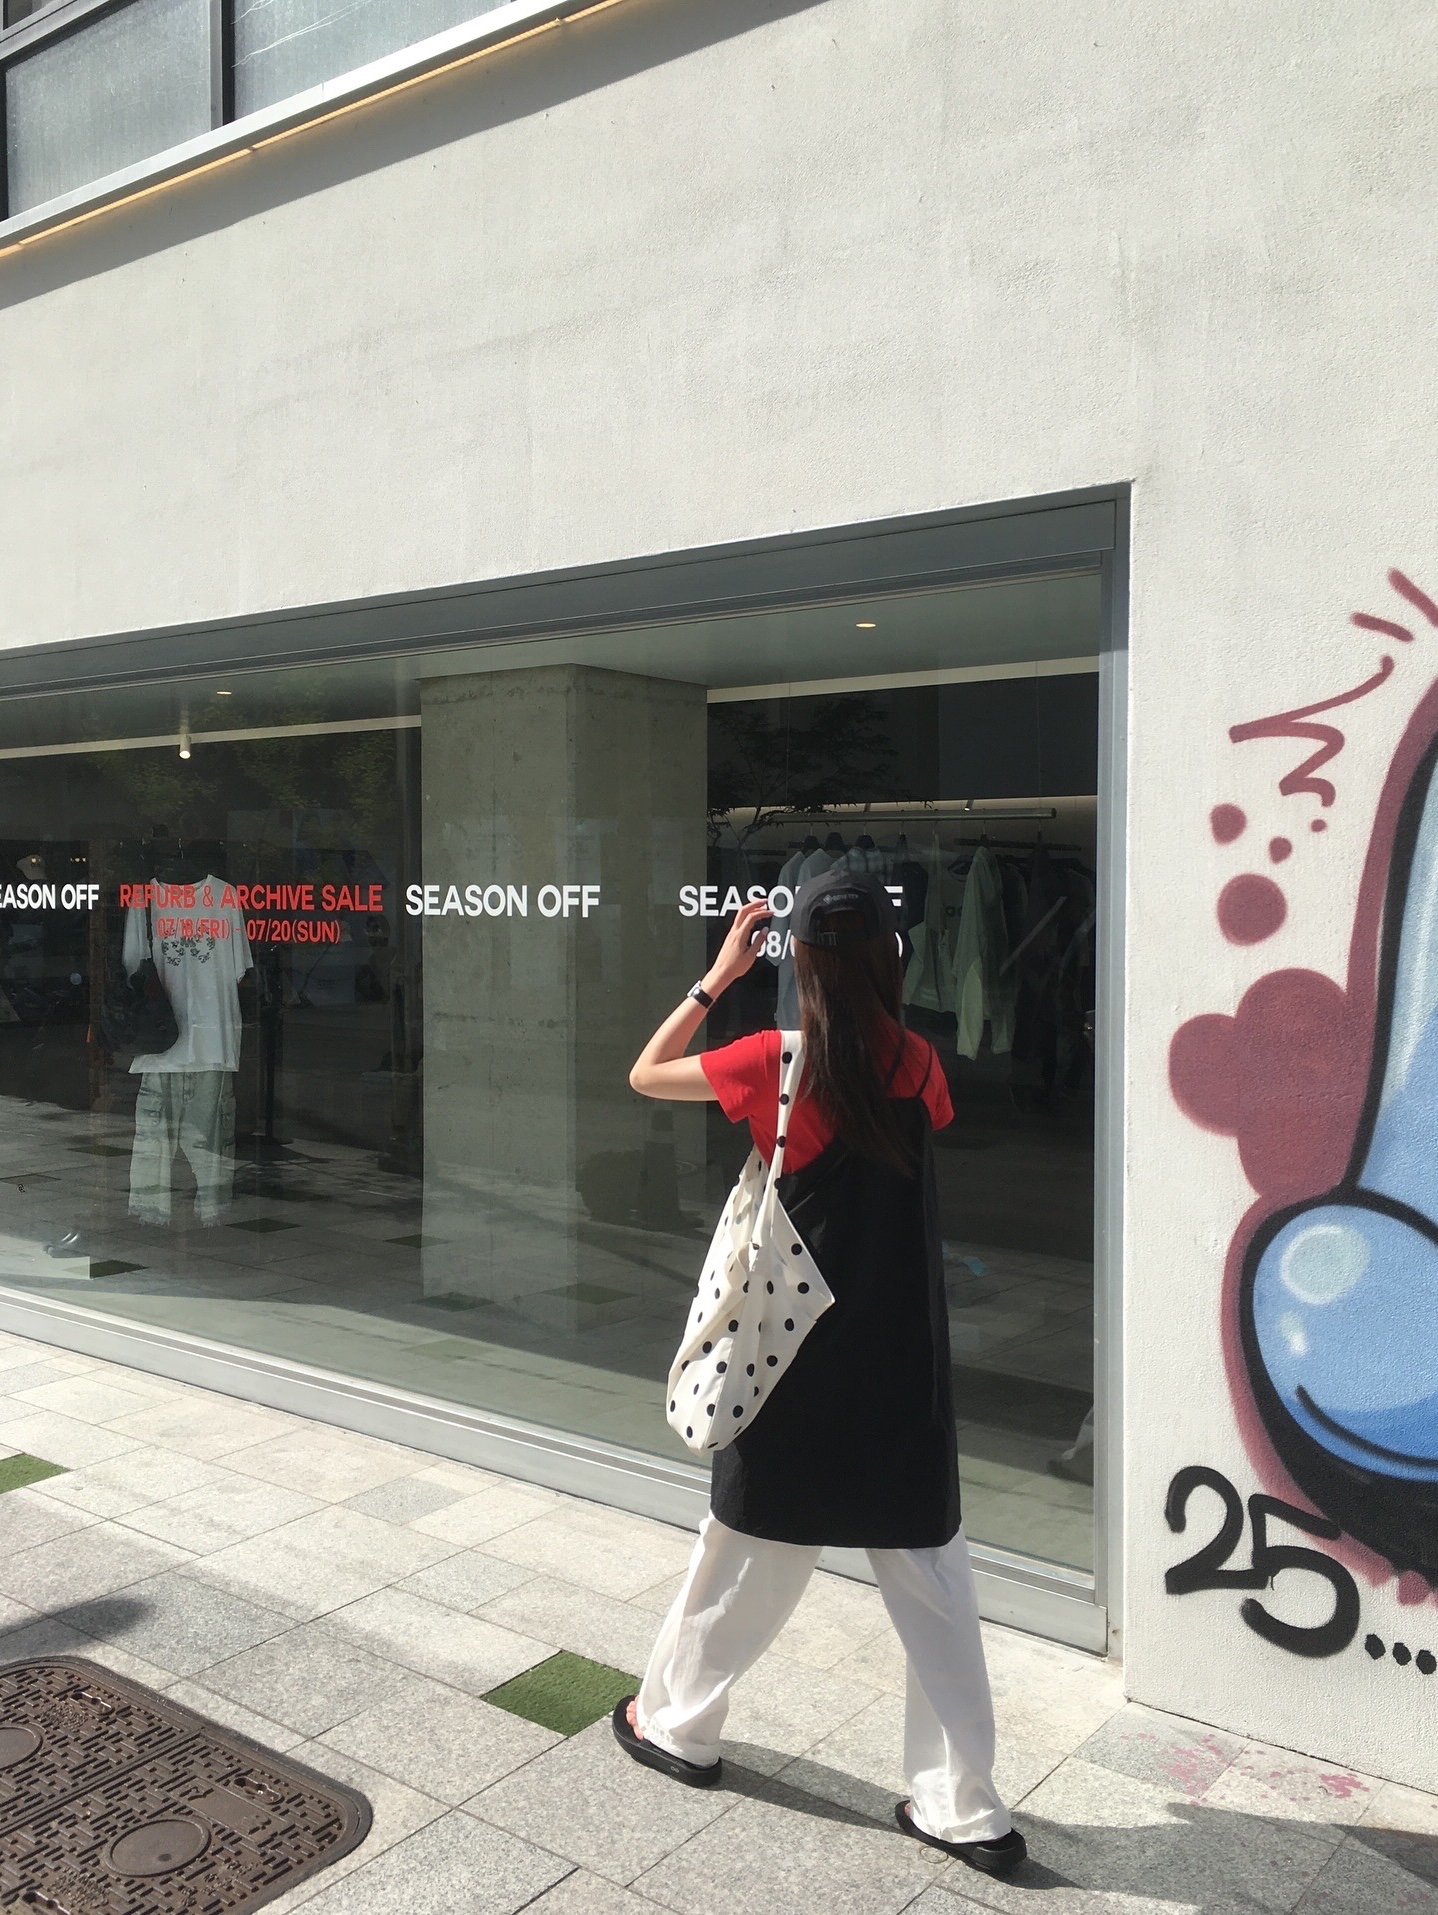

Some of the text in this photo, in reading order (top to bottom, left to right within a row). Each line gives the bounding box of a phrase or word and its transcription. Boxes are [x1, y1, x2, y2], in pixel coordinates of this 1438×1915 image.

[0, 884, 99, 910] ASON OFF
[119, 884, 384, 912] REFURB & ARCHIVE SALE
[405, 884, 600, 918] SEASON OFF
[678, 885, 802, 918] SEASO
[156, 917, 231, 940] 07/18(FRI)
[247, 919, 340, 944] 07/20(SUN)
